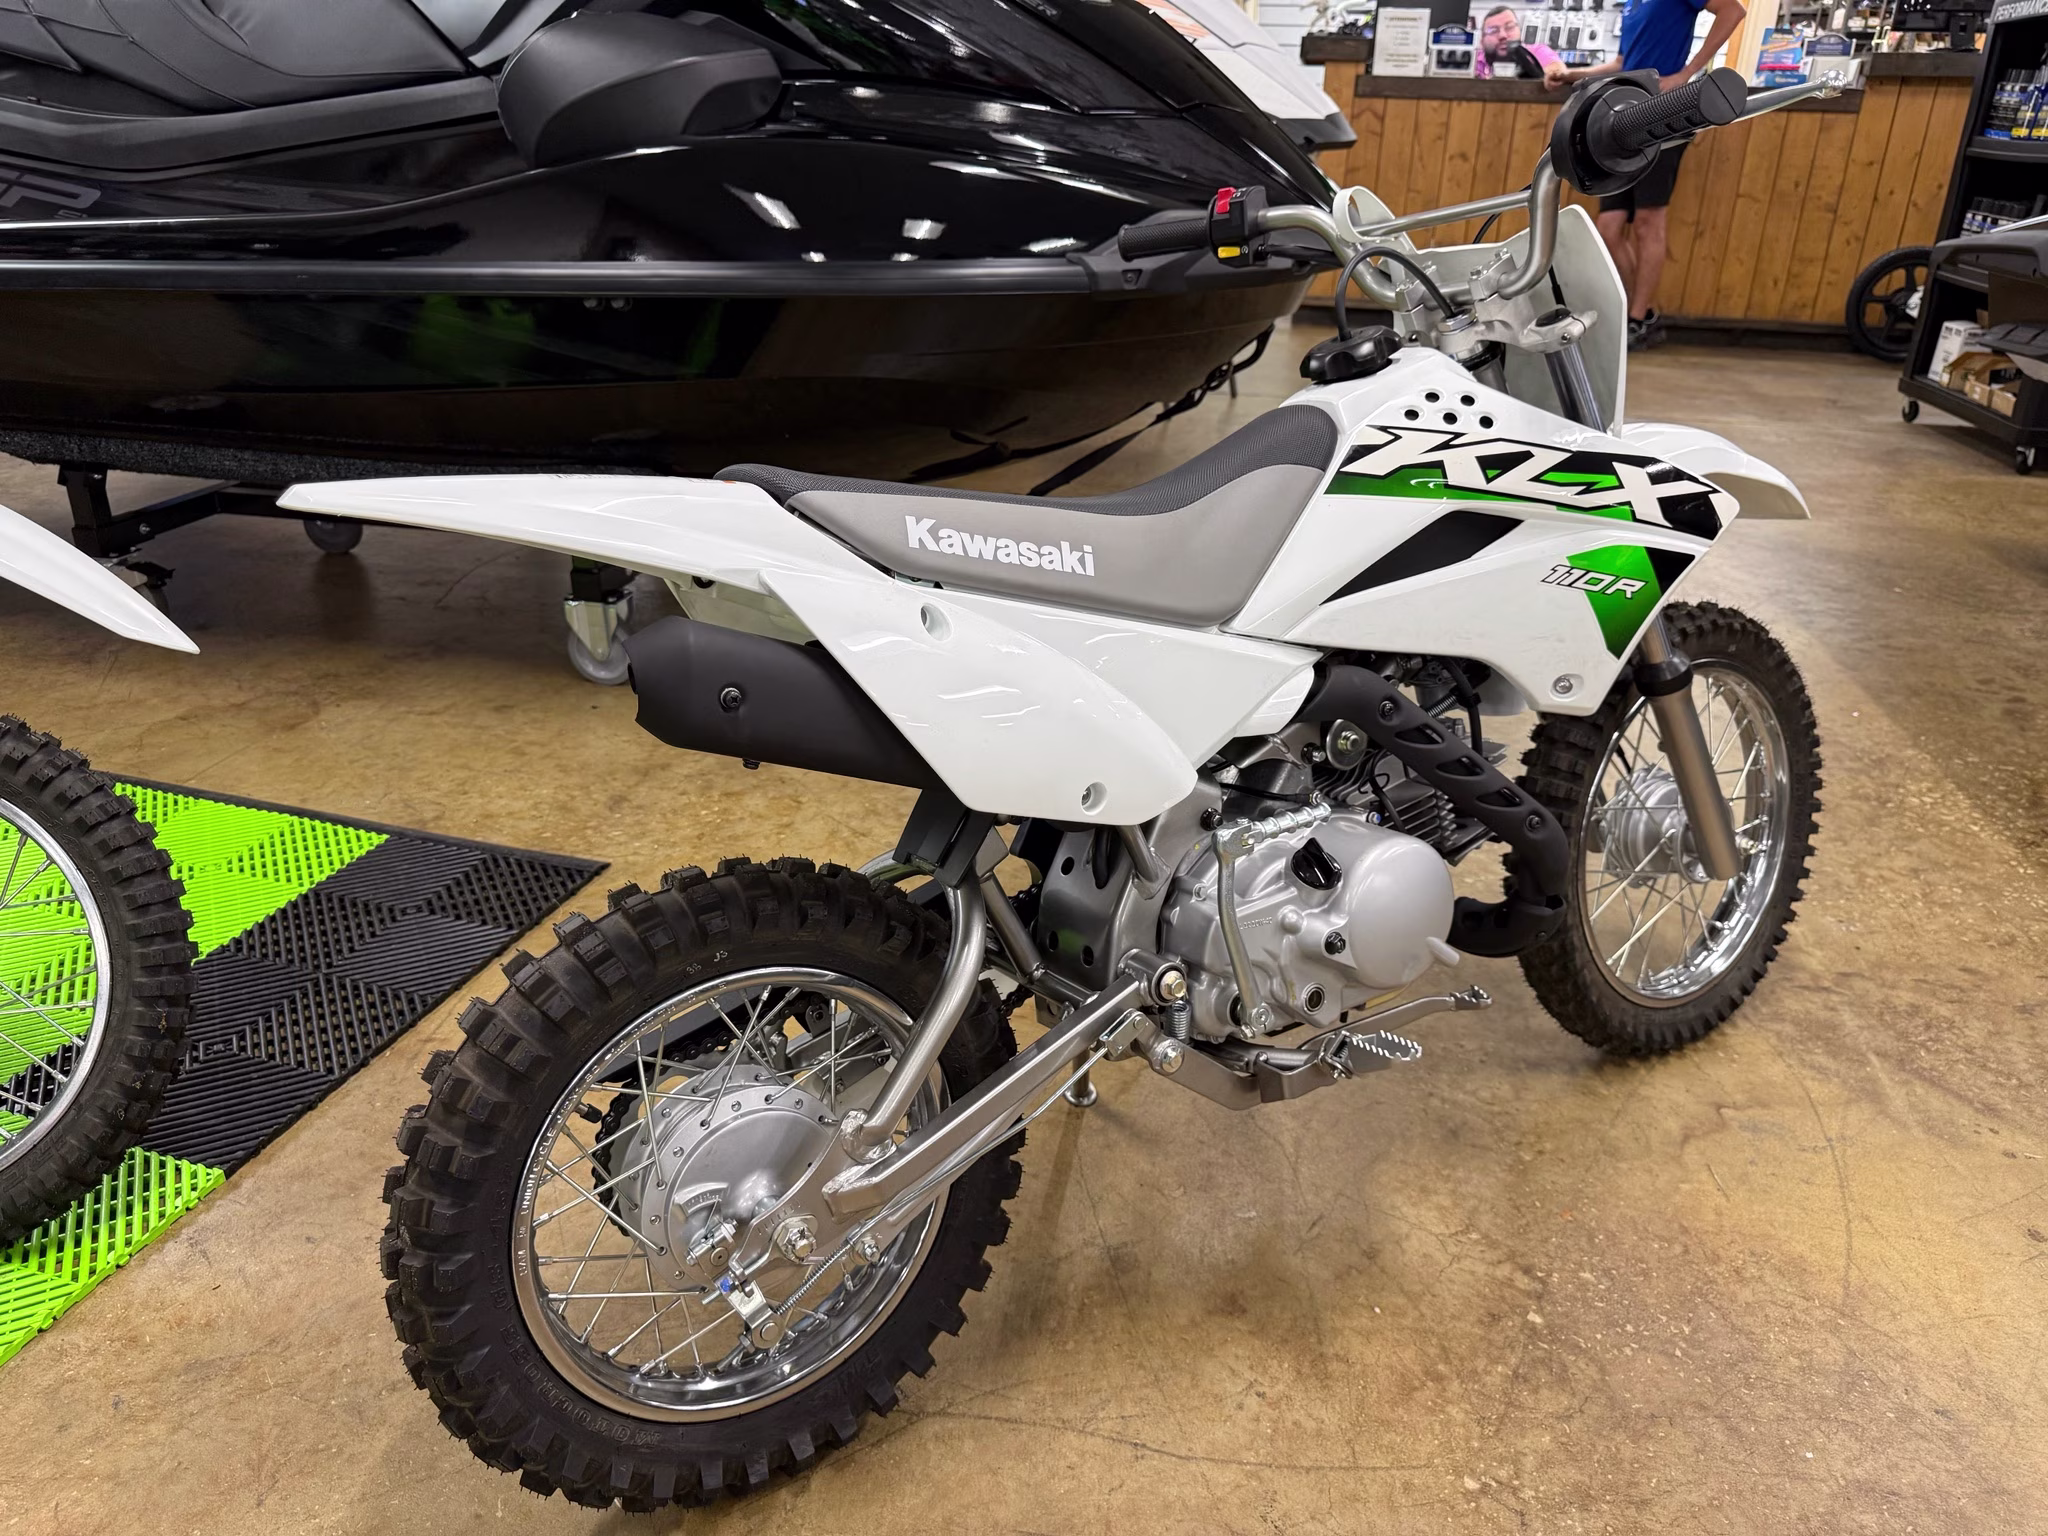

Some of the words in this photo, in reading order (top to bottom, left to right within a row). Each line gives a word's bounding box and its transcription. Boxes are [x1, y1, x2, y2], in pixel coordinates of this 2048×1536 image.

[1994, 0, 2048, 20] PERFORMANC
[1340, 425, 1714, 528] KLX
[904, 515, 1095, 577] Kawasaki
[1540, 563, 1649, 599] 110R
[520, 1173, 538, 1215] UNION
[533, 1127, 558, 1172] CYCLE
[499, 1319, 662, 1449] MOTOCROSS
